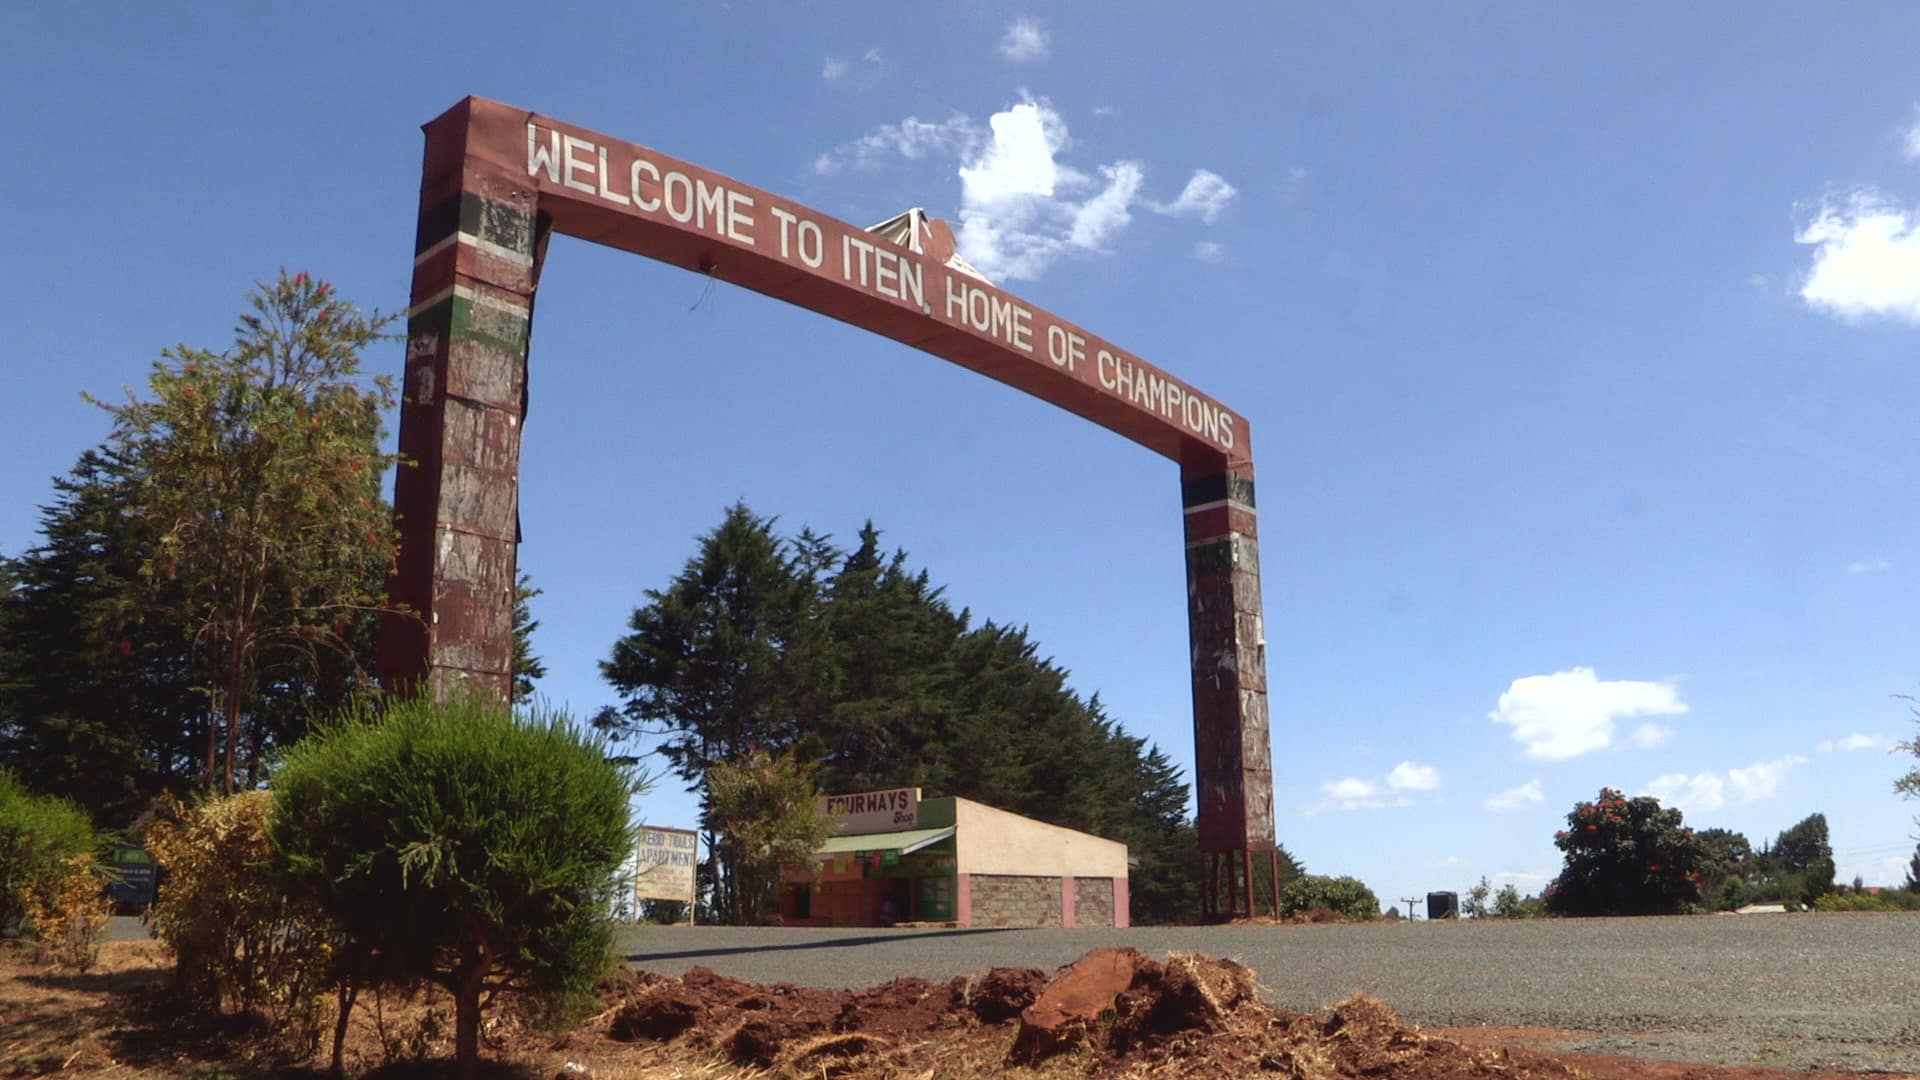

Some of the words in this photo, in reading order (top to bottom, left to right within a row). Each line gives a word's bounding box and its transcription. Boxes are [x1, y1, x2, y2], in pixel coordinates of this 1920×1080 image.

[527, 122, 755, 246] WELCOME
[770, 206, 824, 270] TO
[945, 275, 1033, 353] HOME
[1047, 324, 1086, 372] OF
[1097, 349, 1234, 450] CHAMPIONS
